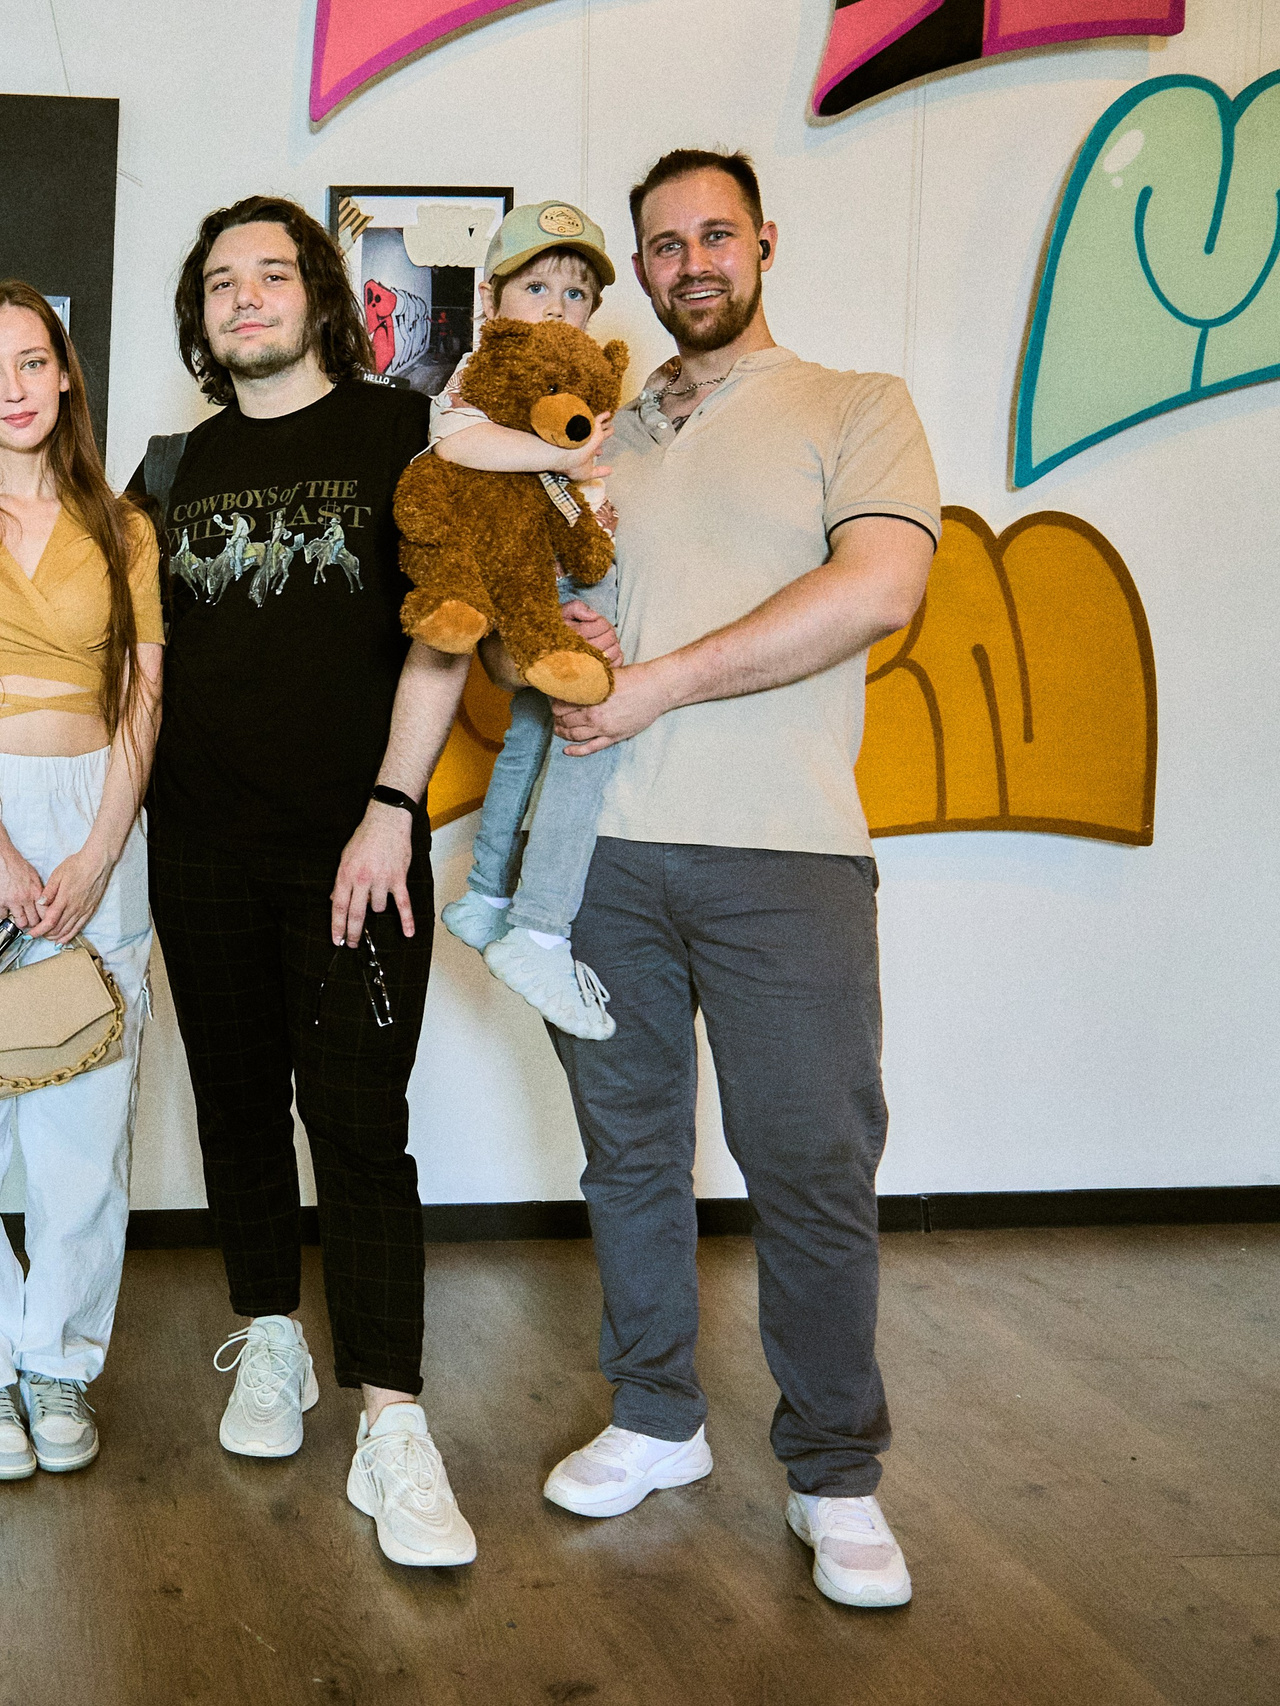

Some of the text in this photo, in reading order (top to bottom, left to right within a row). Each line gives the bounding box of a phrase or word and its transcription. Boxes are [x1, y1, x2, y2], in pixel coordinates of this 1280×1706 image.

[363, 373, 390, 385] HELLO
[173, 480, 358, 522] COWBOYS of THE
